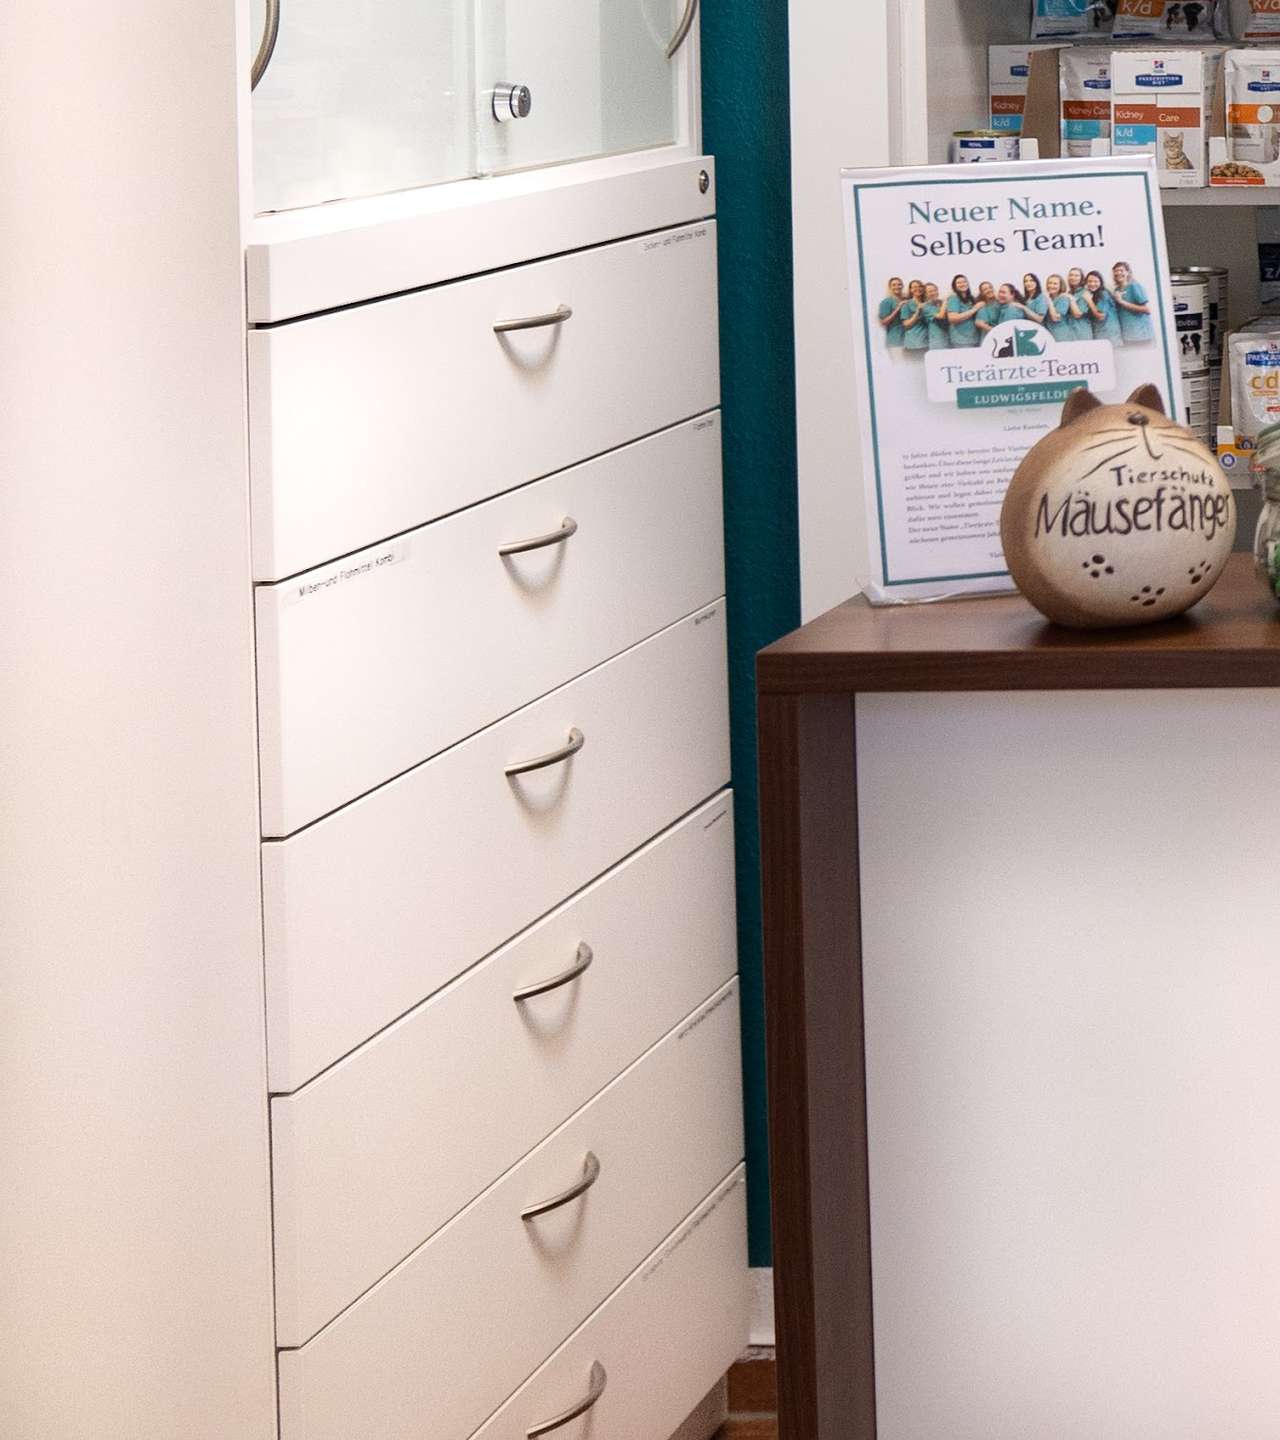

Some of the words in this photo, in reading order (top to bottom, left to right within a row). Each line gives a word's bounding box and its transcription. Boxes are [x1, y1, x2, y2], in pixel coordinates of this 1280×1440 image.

[1116, 109, 1144, 121] Kidney
[1159, 113, 1180, 122] Care
[1116, 127, 1133, 137] k/d
[909, 201, 999, 224] Neuer
[1008, 196, 1102, 220] Name.
[911, 231, 1005, 257] Selbes
[1014, 225, 1105, 251] Team!
[941, 359, 1100, 384] Tierärzte-Team
[1110, 464, 1215, 487] Tierschutz
